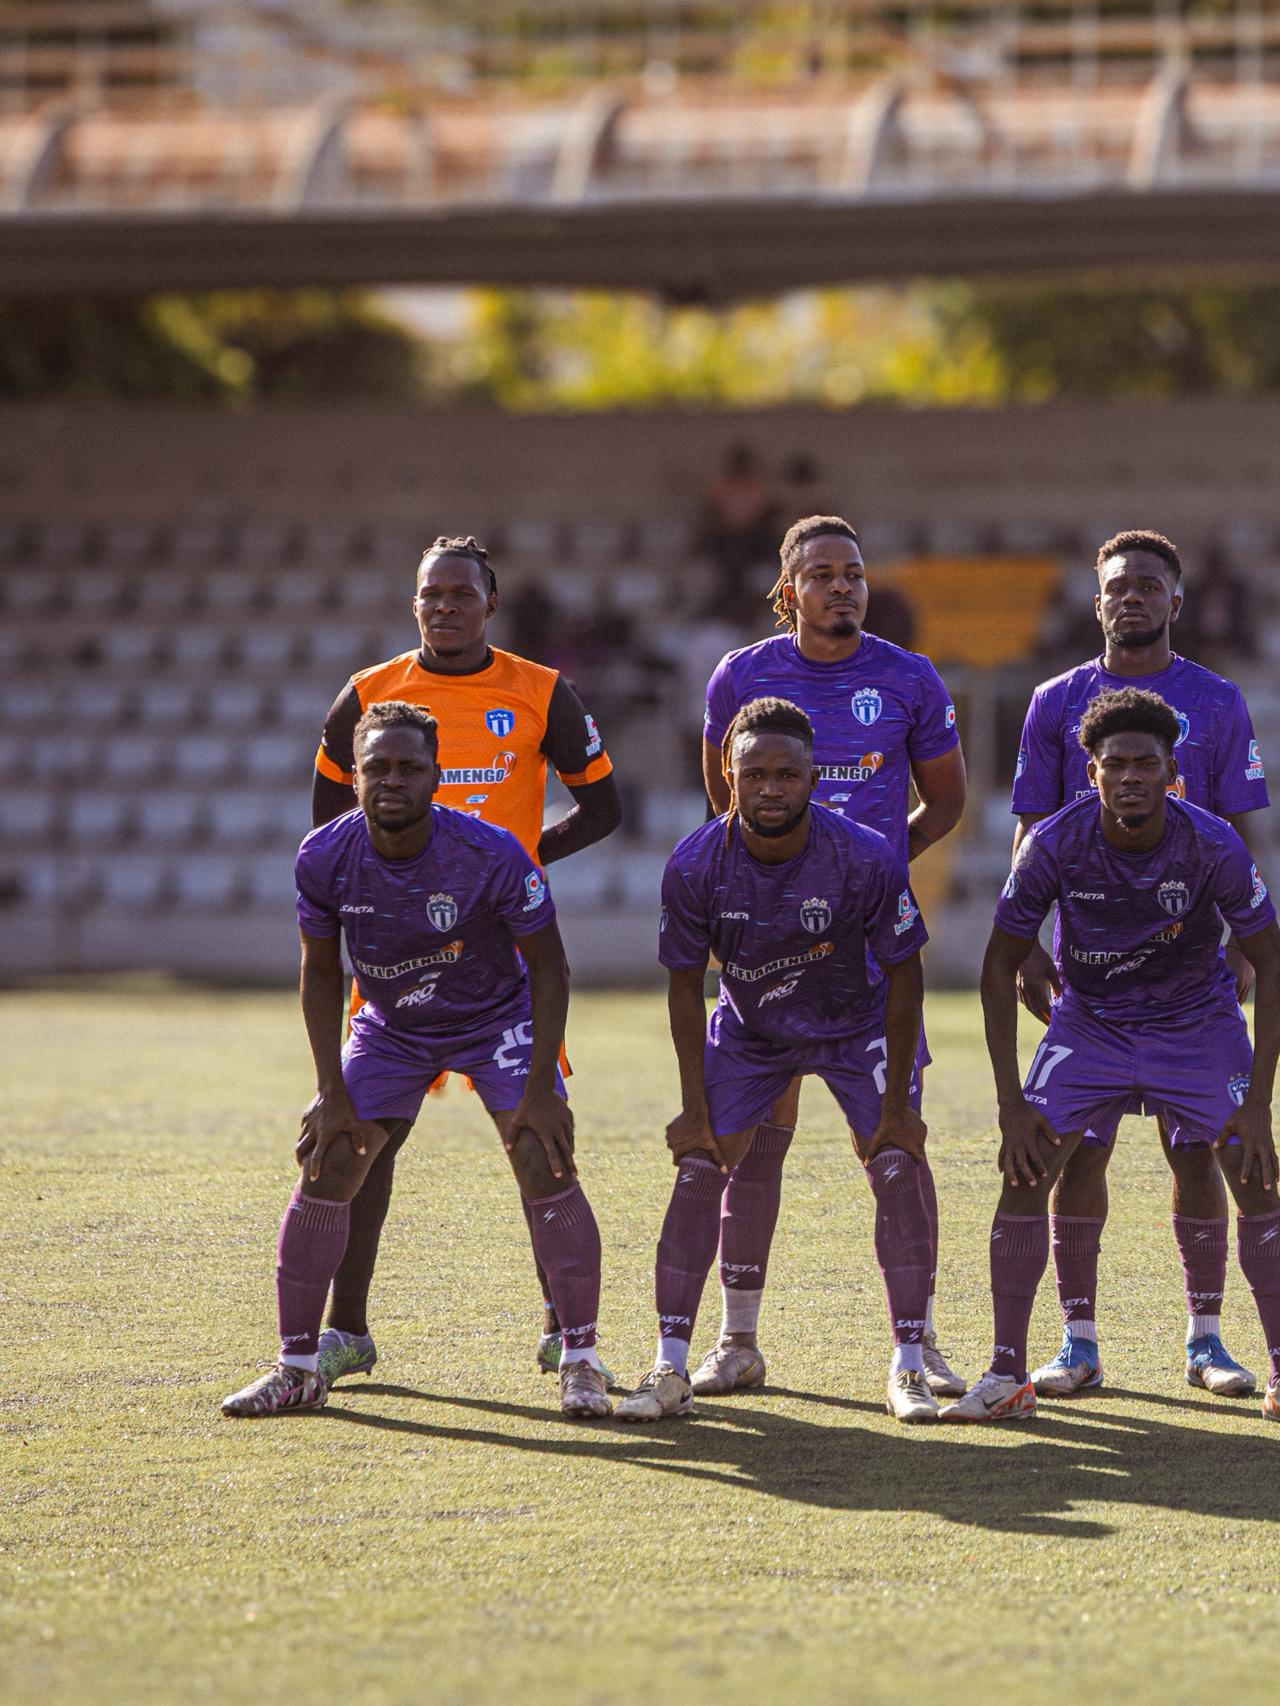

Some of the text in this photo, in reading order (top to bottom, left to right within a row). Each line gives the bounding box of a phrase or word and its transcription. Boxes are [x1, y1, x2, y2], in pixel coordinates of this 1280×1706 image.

[438, 768, 505, 785] AMENGO
[817, 765, 875, 782] MENGO
[1067, 891, 1105, 900] SAETA
[339, 904, 375, 914] SAETA
[368, 949, 458, 980] FLAMENGO
[395, 983, 437, 1008] PRO
[758, 980, 798, 1008] PRO
[1024, 1042, 1074, 1092] 17
[1024, 1093, 1048, 1106] AETA
[659, 1315, 691, 1326] AETA
[895, 1319, 926, 1329] SAET
